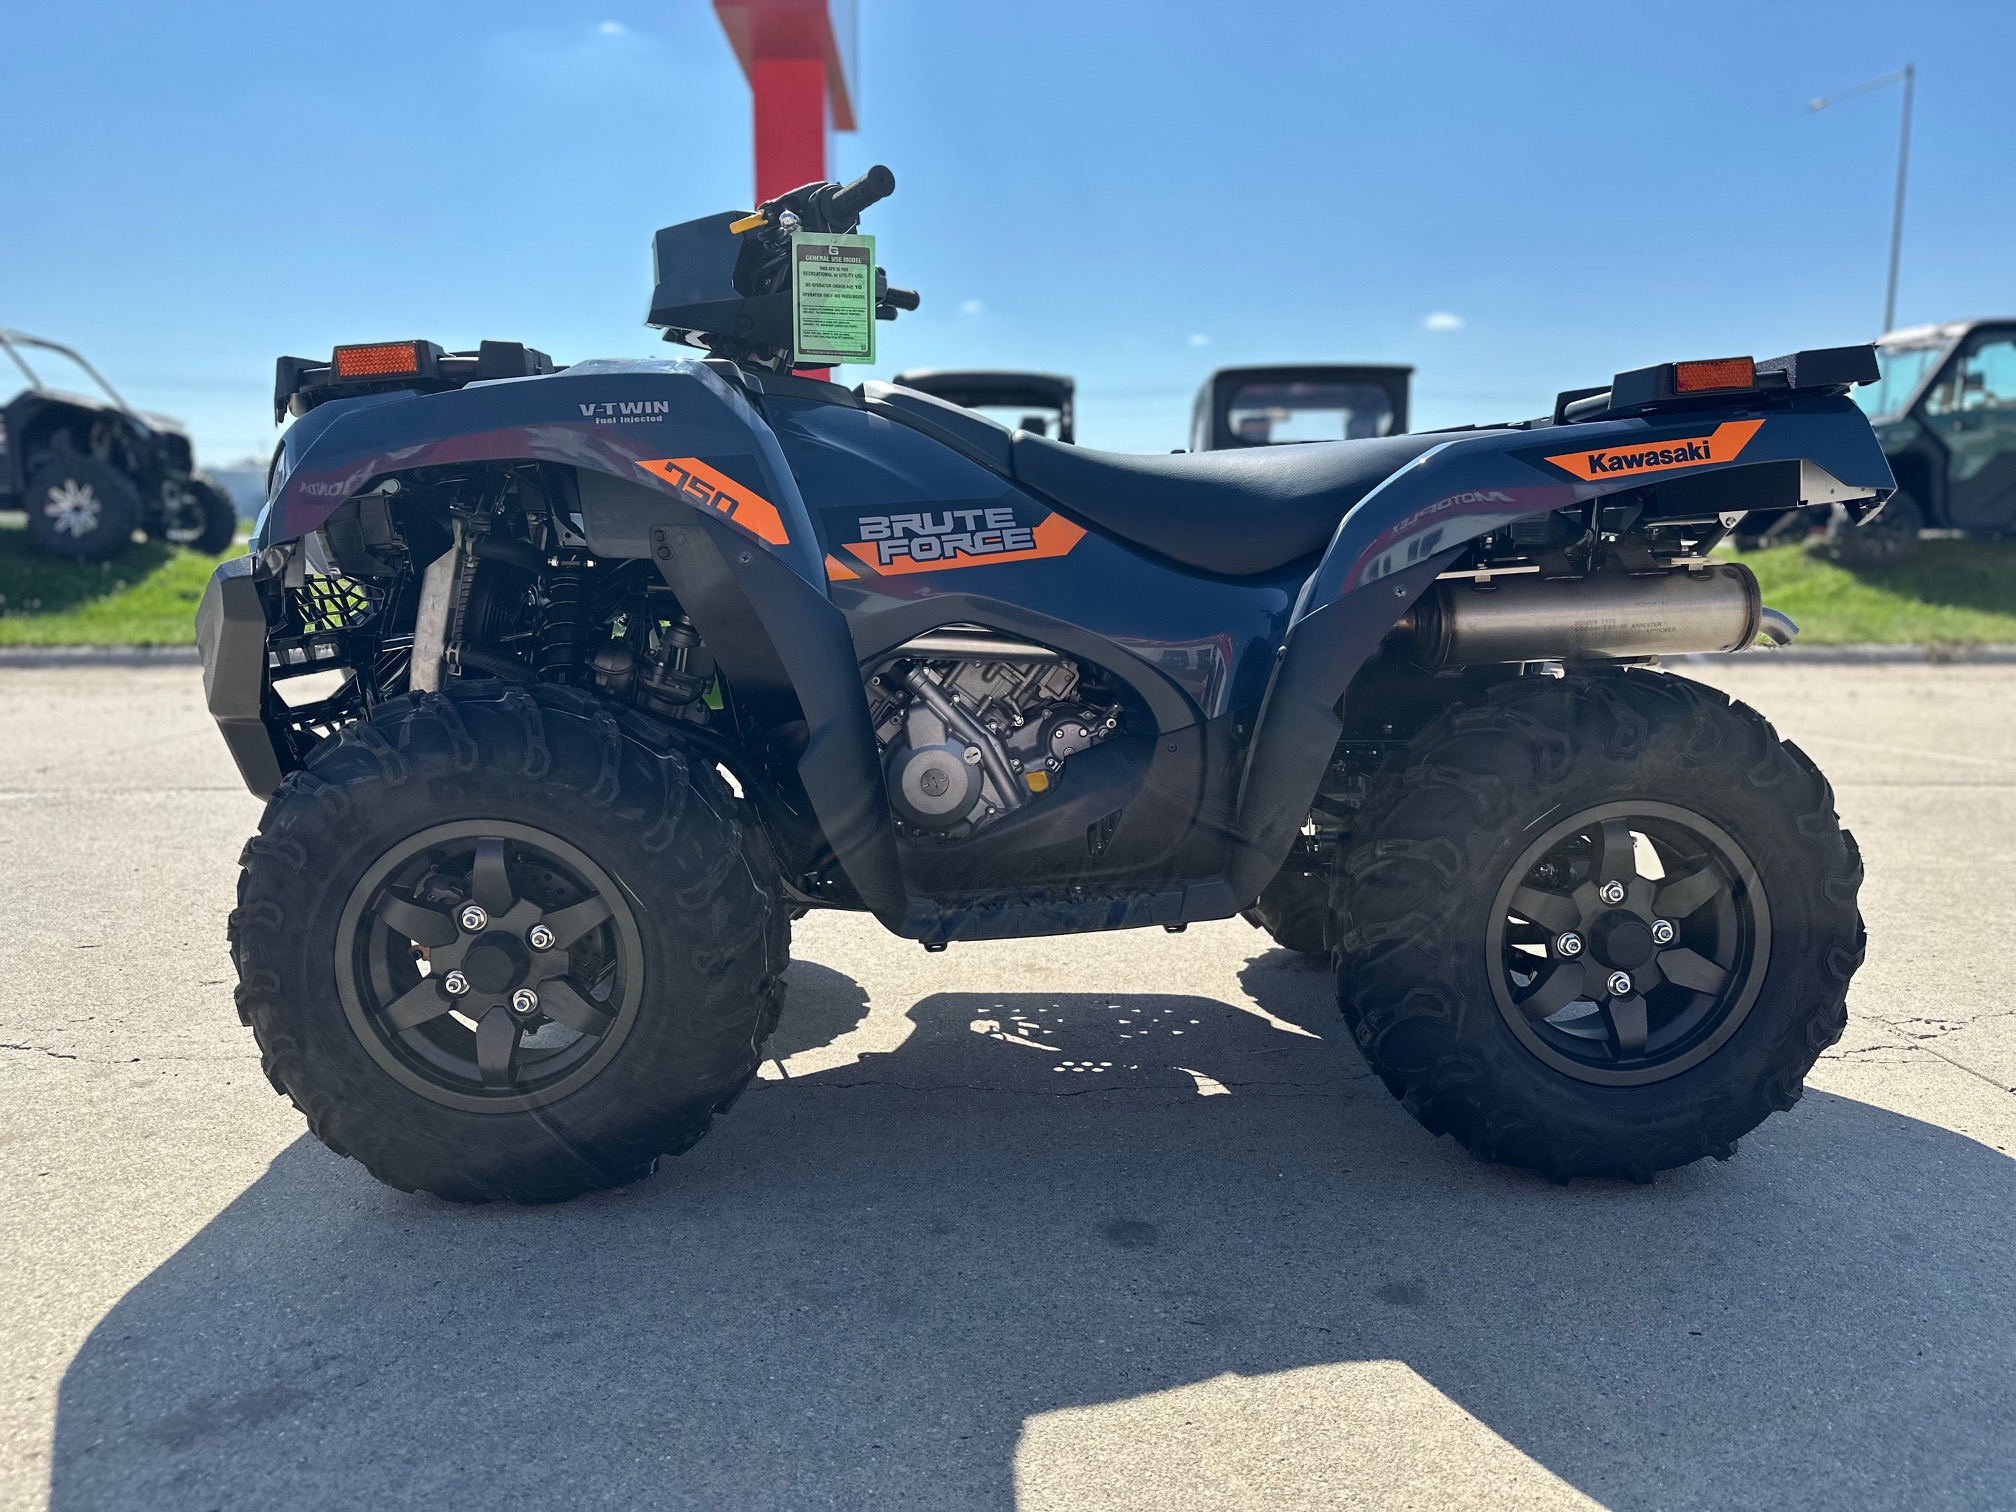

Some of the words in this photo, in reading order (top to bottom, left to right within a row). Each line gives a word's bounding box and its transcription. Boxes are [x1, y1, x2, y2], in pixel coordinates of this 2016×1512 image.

[805, 254, 830, 262] GENERAL
[579, 400, 669, 416] V-TWIN
[595, 416, 617, 425] Fuel
[620, 415, 663, 424] Injected
[1588, 440, 1711, 474] Kawasaki
[664, 461, 740, 518] 750
[858, 507, 1017, 541] BRUTE
[878, 527, 1037, 566] FORCE
[1631, 621, 1662, 629] ARRESTER
